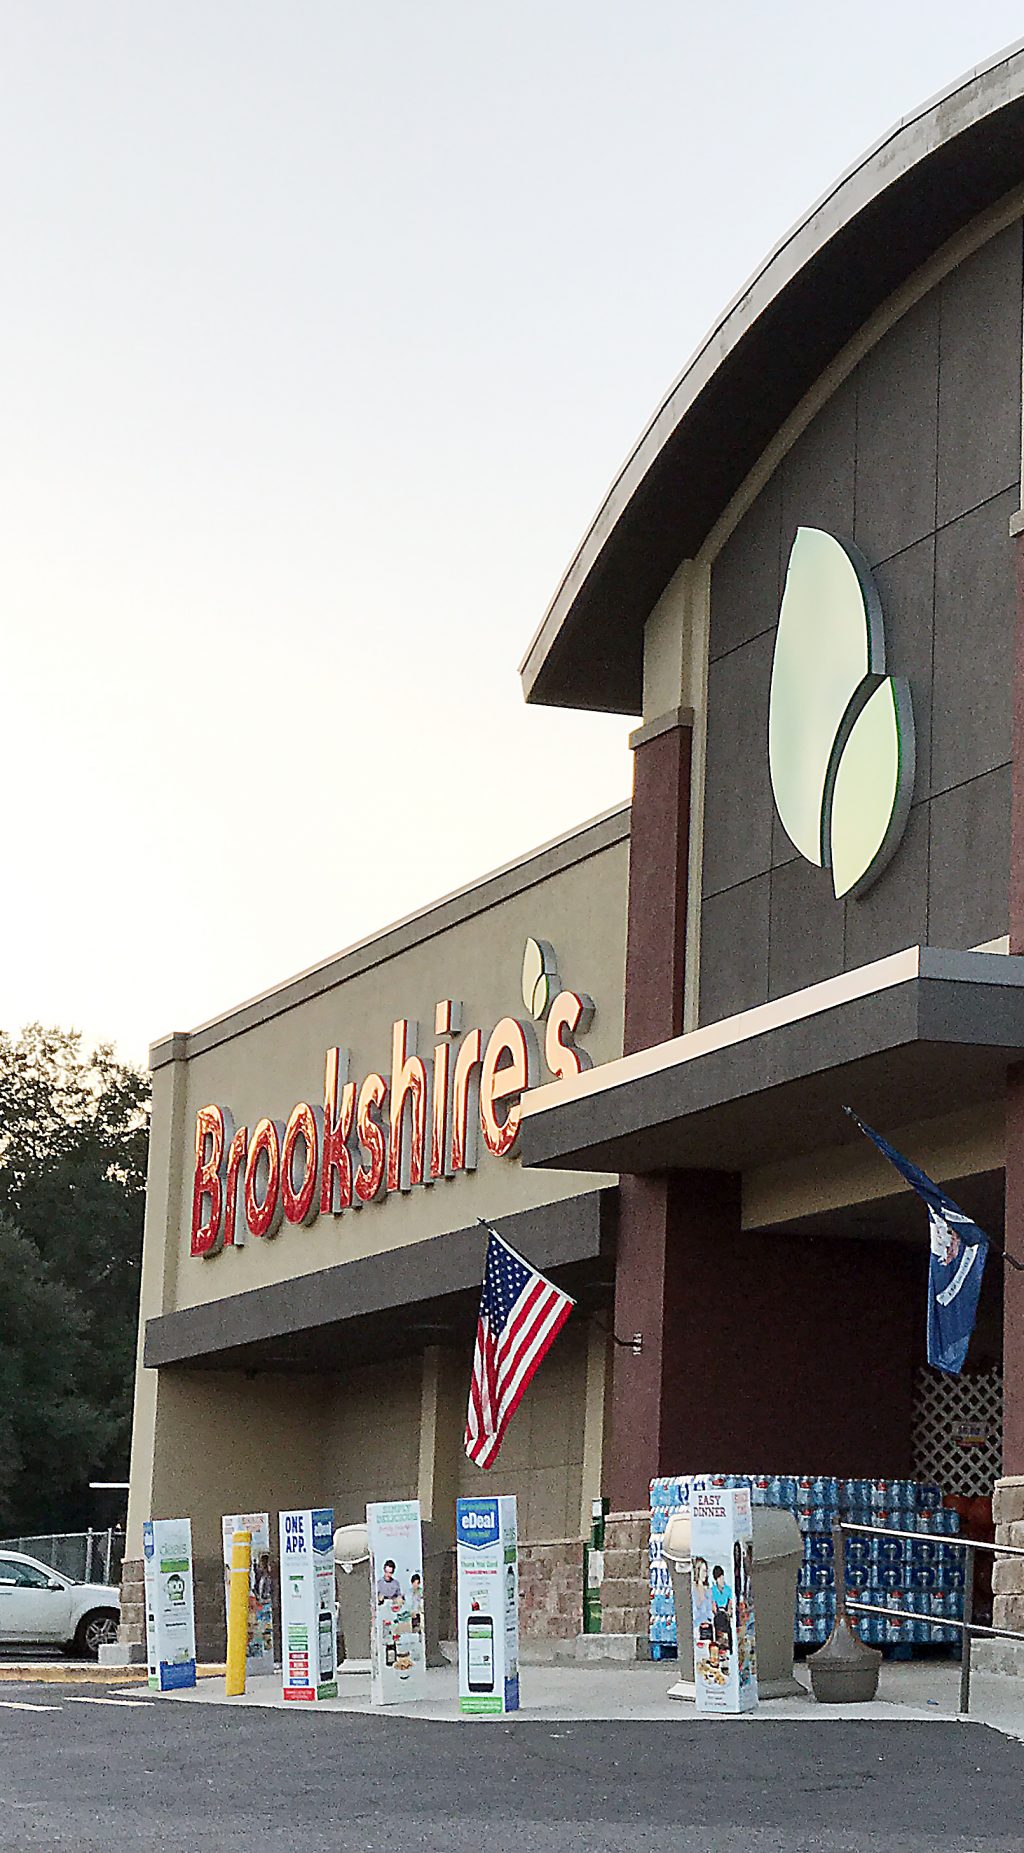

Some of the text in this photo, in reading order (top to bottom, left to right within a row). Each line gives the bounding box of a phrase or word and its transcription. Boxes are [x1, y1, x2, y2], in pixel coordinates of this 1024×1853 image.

[698, 1495, 721, 1506] EASY
[461, 1511, 495, 1529] eDeal
[693, 1506, 727, 1518] DINNER
[285, 1515, 304, 1534] ONE
[285, 1535, 307, 1553] APP.
